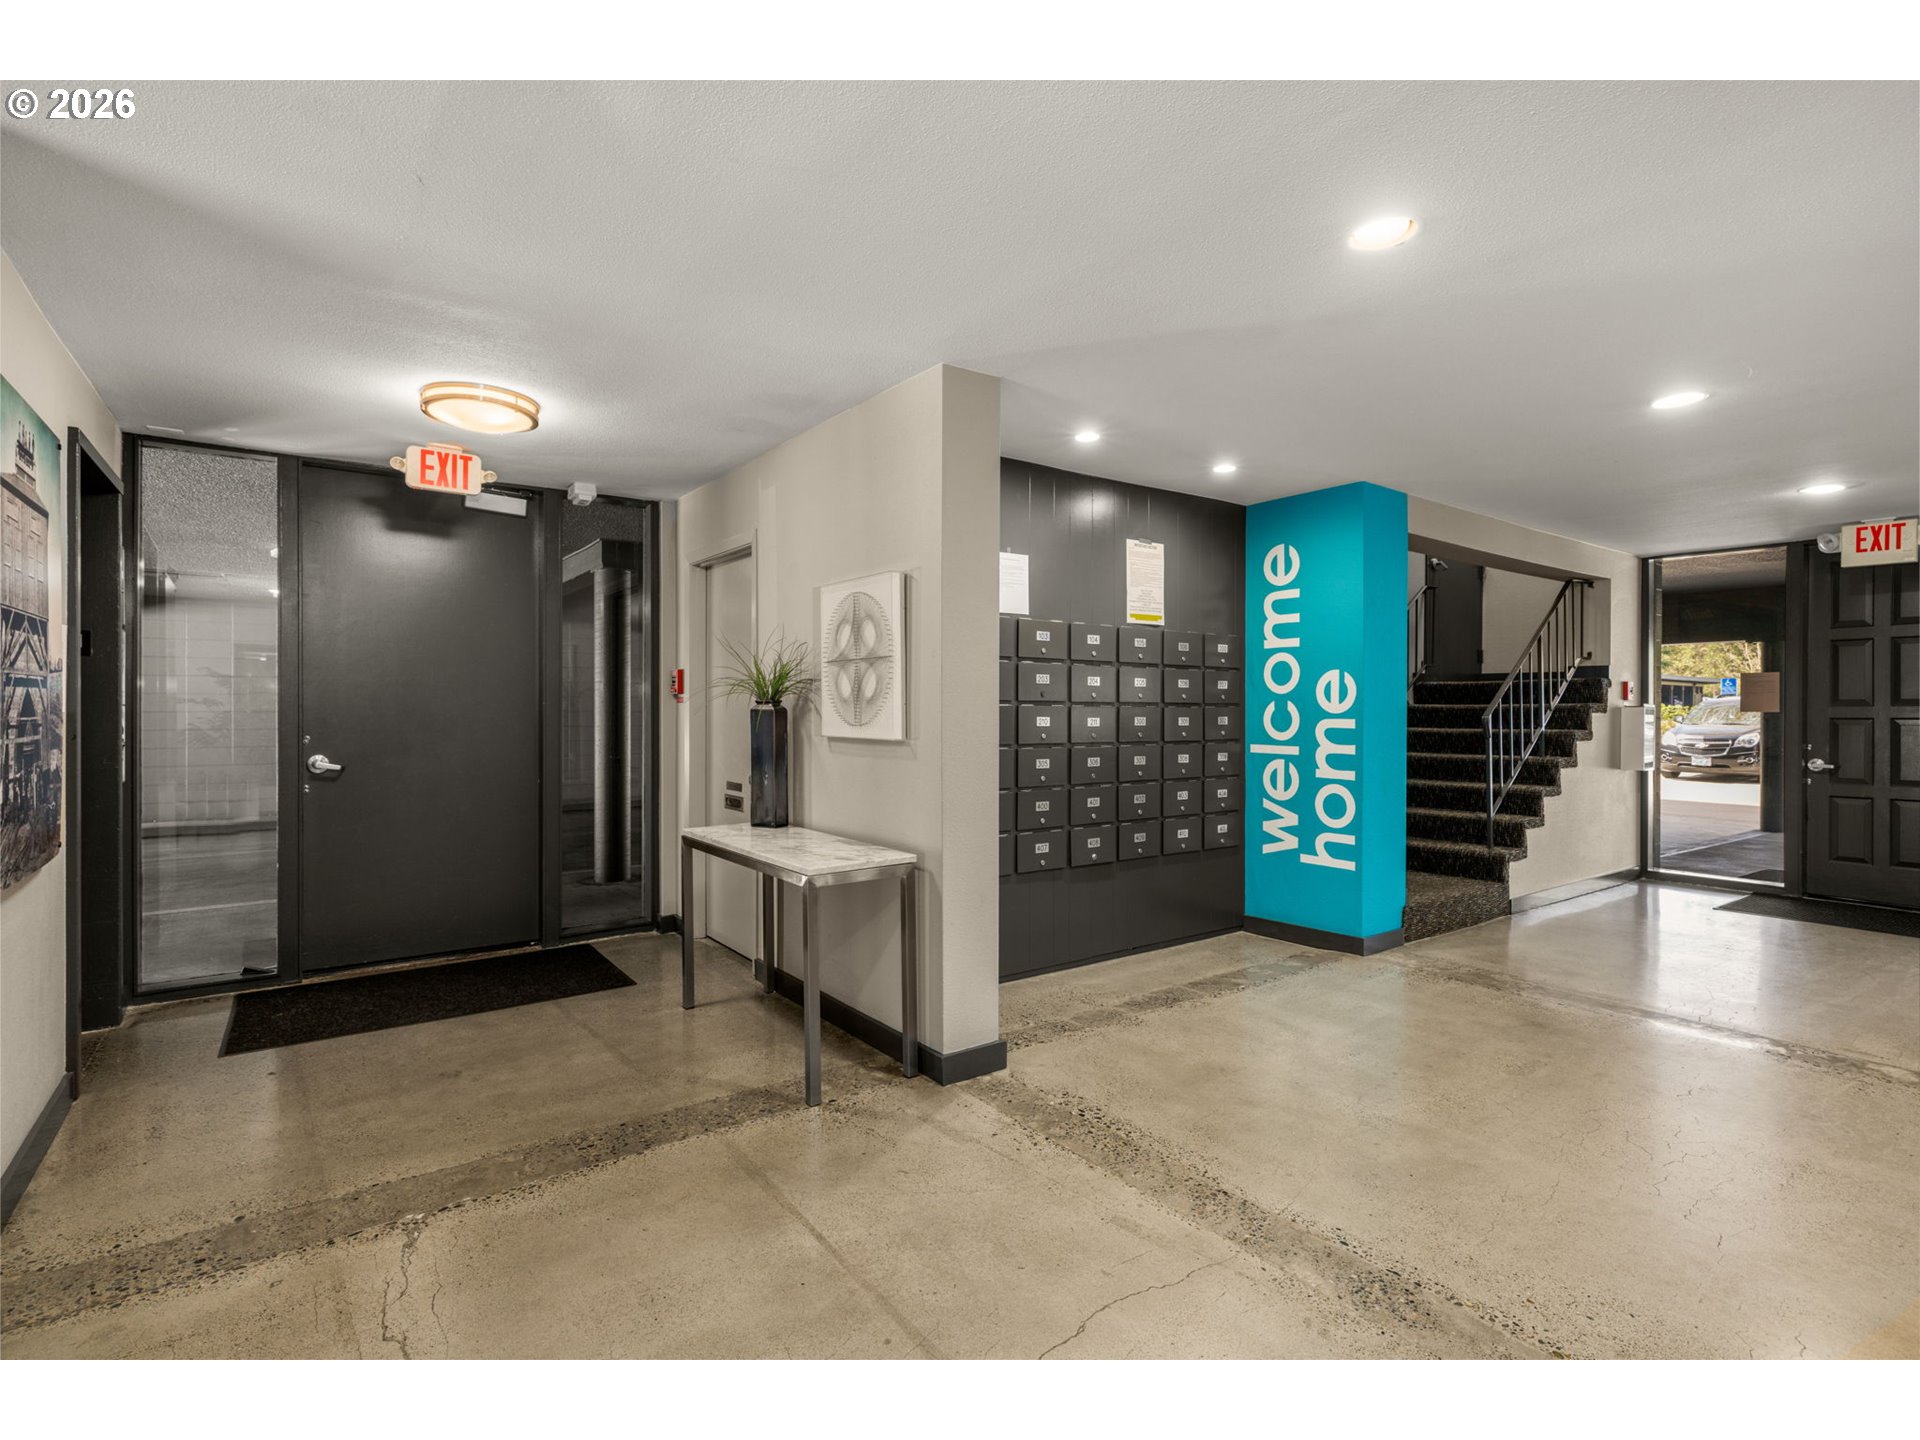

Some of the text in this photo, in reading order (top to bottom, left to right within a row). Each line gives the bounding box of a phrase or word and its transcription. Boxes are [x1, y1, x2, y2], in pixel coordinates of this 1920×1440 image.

[420, 449, 473, 490] EXIT
[1855, 522, 1906, 553] EXIT
[1038, 632, 1049, 640] 103
[1037, 675, 1049, 683] 203
[1088, 677, 1098, 685] 204
[1250, 543, 1301, 854] welcome
[1038, 718, 1049, 726] 210
[1038, 760, 1048, 768] 305
[1300, 669, 1358, 872] home
[1037, 802, 1048, 810] 400
[1037, 844, 1048, 852] 407
